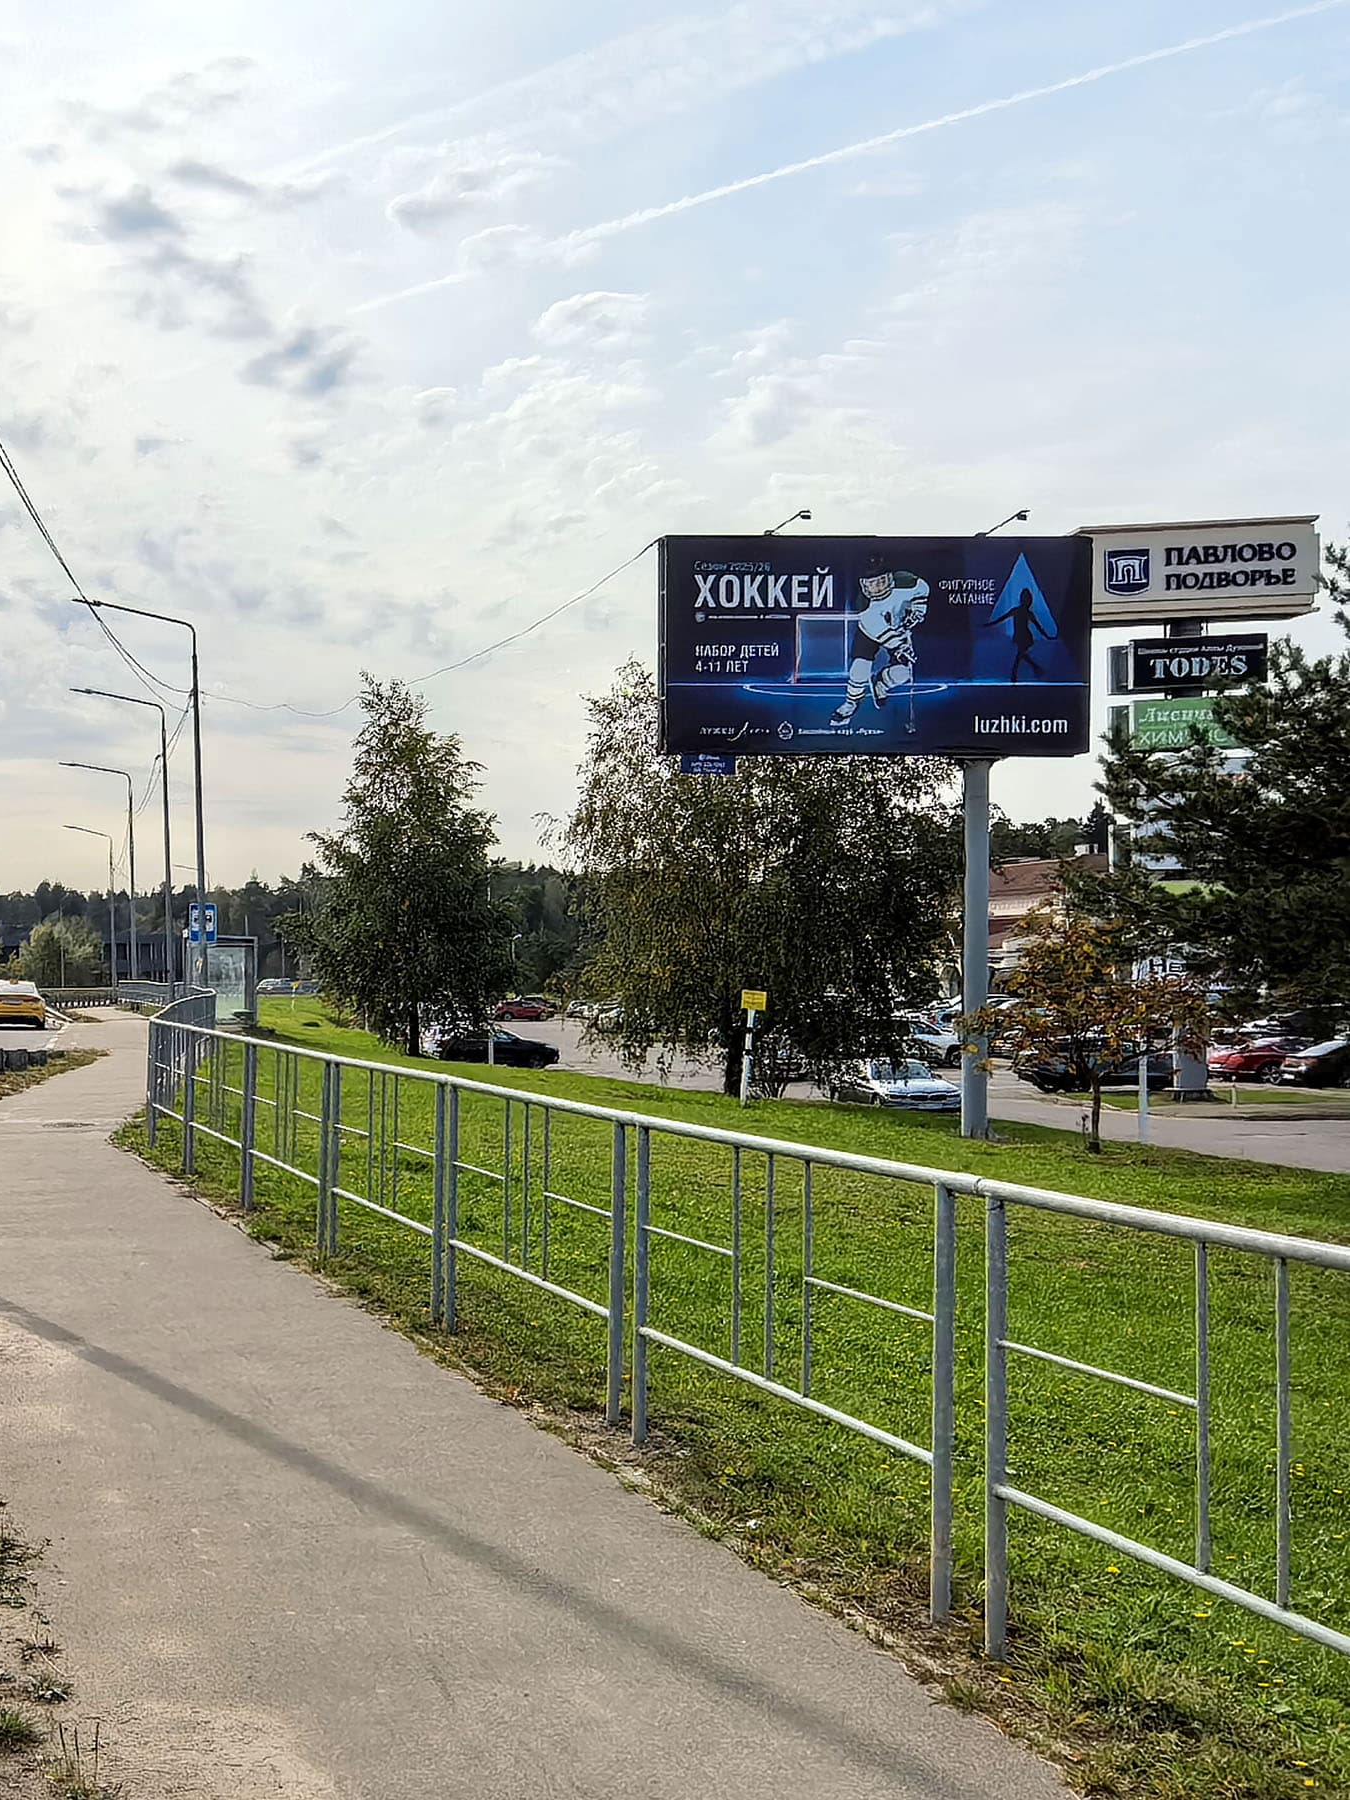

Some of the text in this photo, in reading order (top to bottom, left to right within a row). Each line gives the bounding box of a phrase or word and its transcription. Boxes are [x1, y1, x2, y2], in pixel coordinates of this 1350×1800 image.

[1164, 542, 1297, 567] ПАВЛОВО
[694, 566, 834, 608] ХОККЕЙ
[938, 579, 996, 591] ФИГУРНОЕ
[1164, 568, 1297, 591] ПОДВОРЬЕ
[948, 593, 995, 604] КАТАНИЕ
[695, 642, 779, 658] НАБОР ДЕТЕЙ
[695, 660, 749, 672] 4-11 ЛЕТ
[1150, 655, 1248, 678] TODES
[974, 715, 1068, 733] luzhki.com
